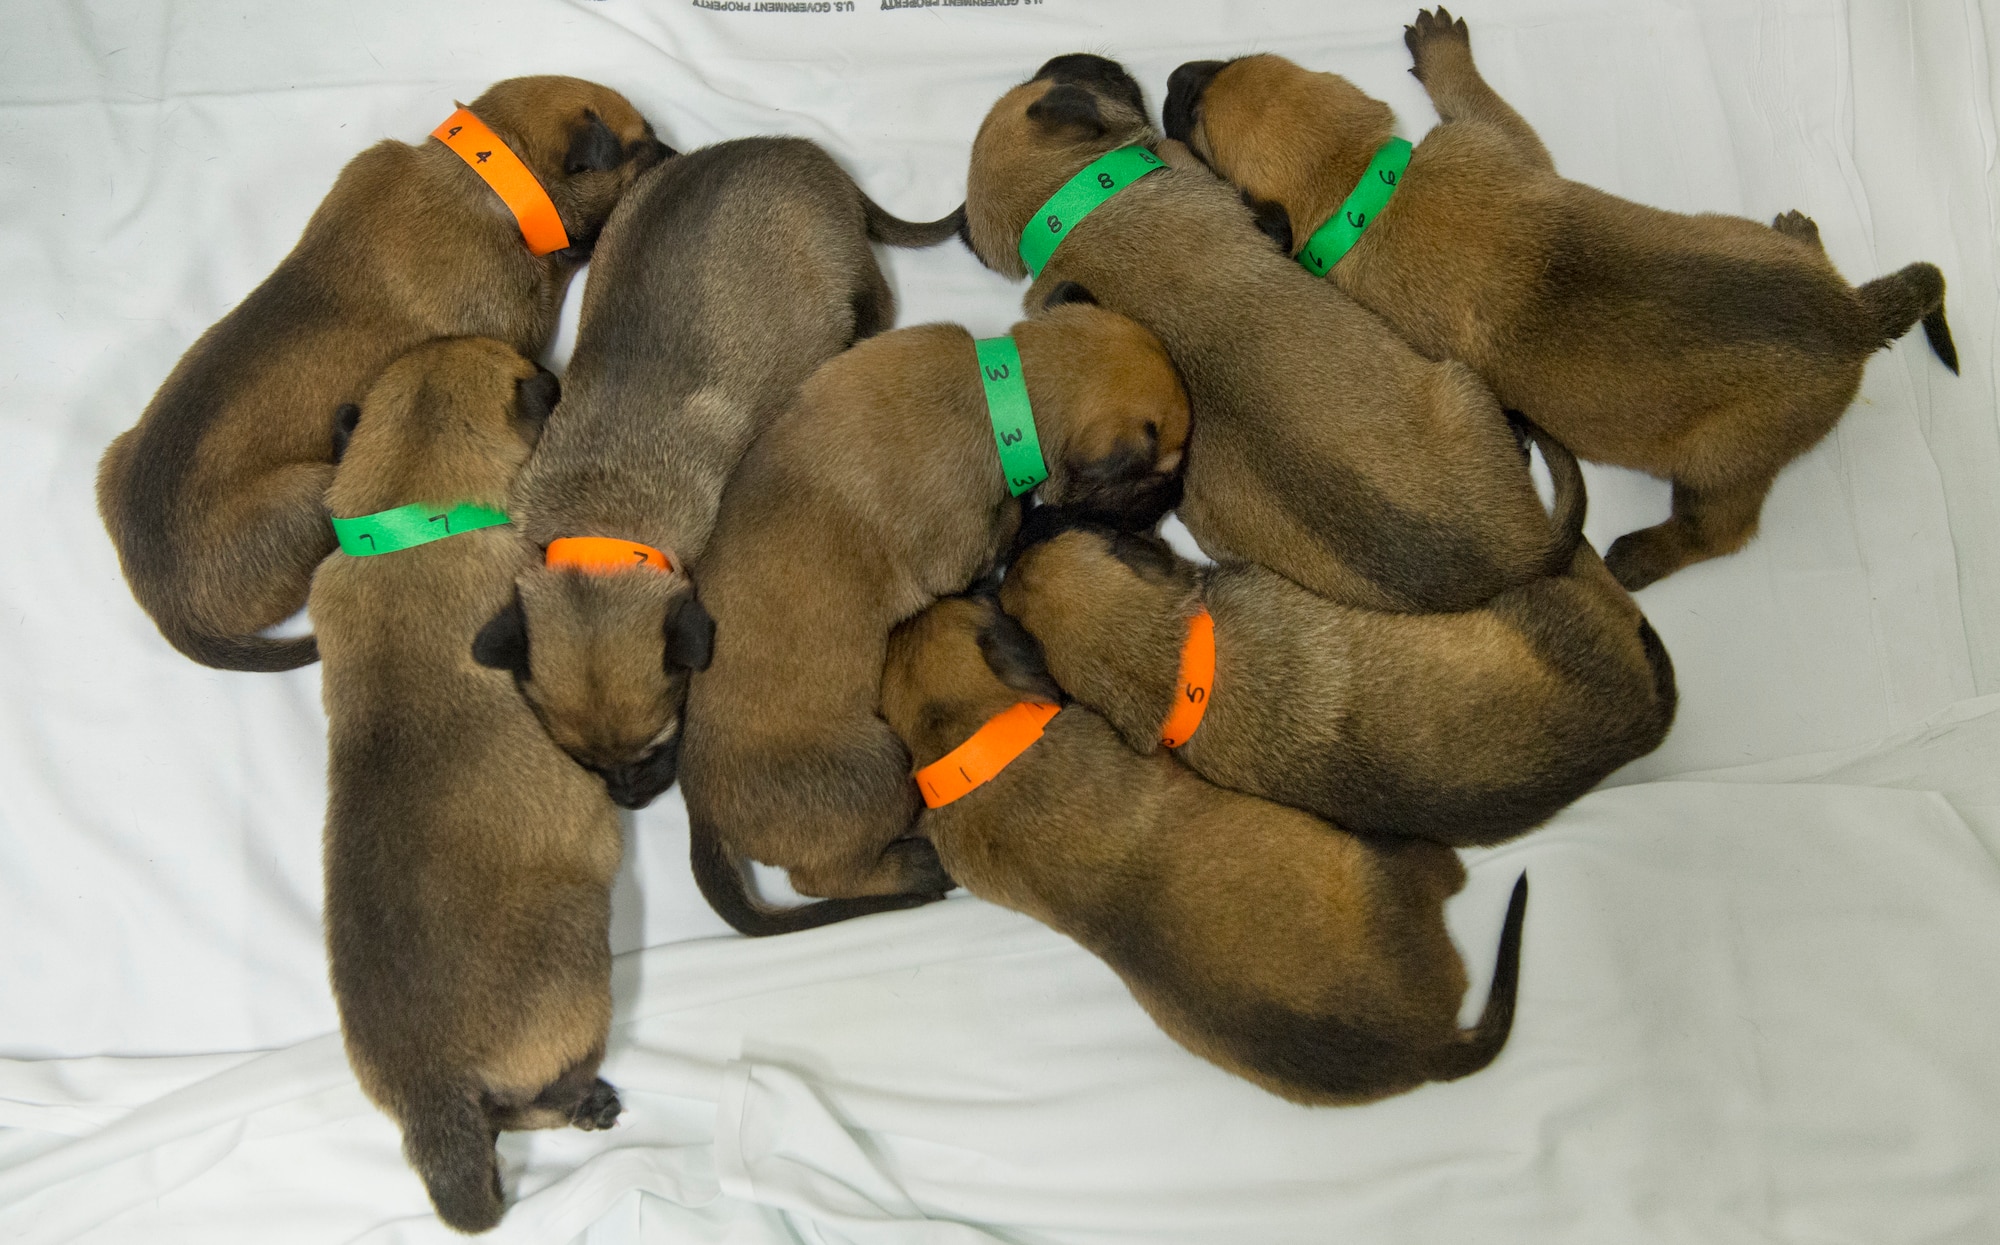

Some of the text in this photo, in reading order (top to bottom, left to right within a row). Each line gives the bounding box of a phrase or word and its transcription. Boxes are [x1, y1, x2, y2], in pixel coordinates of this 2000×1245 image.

[692, 0, 854, 12] U.S. GOVERNMENT PROPERTY
[448, 126, 492, 164] 4 4
[1047, 215, 1063, 233] 8
[1098, 173, 1115, 189] 8
[1347, 211, 1365, 228] 6
[1379, 170, 1396, 186] 6
[985, 364, 1035, 487] 3 3 3
[359, 513, 450, 551] 7 7
[1186, 683, 1205, 704] 5
